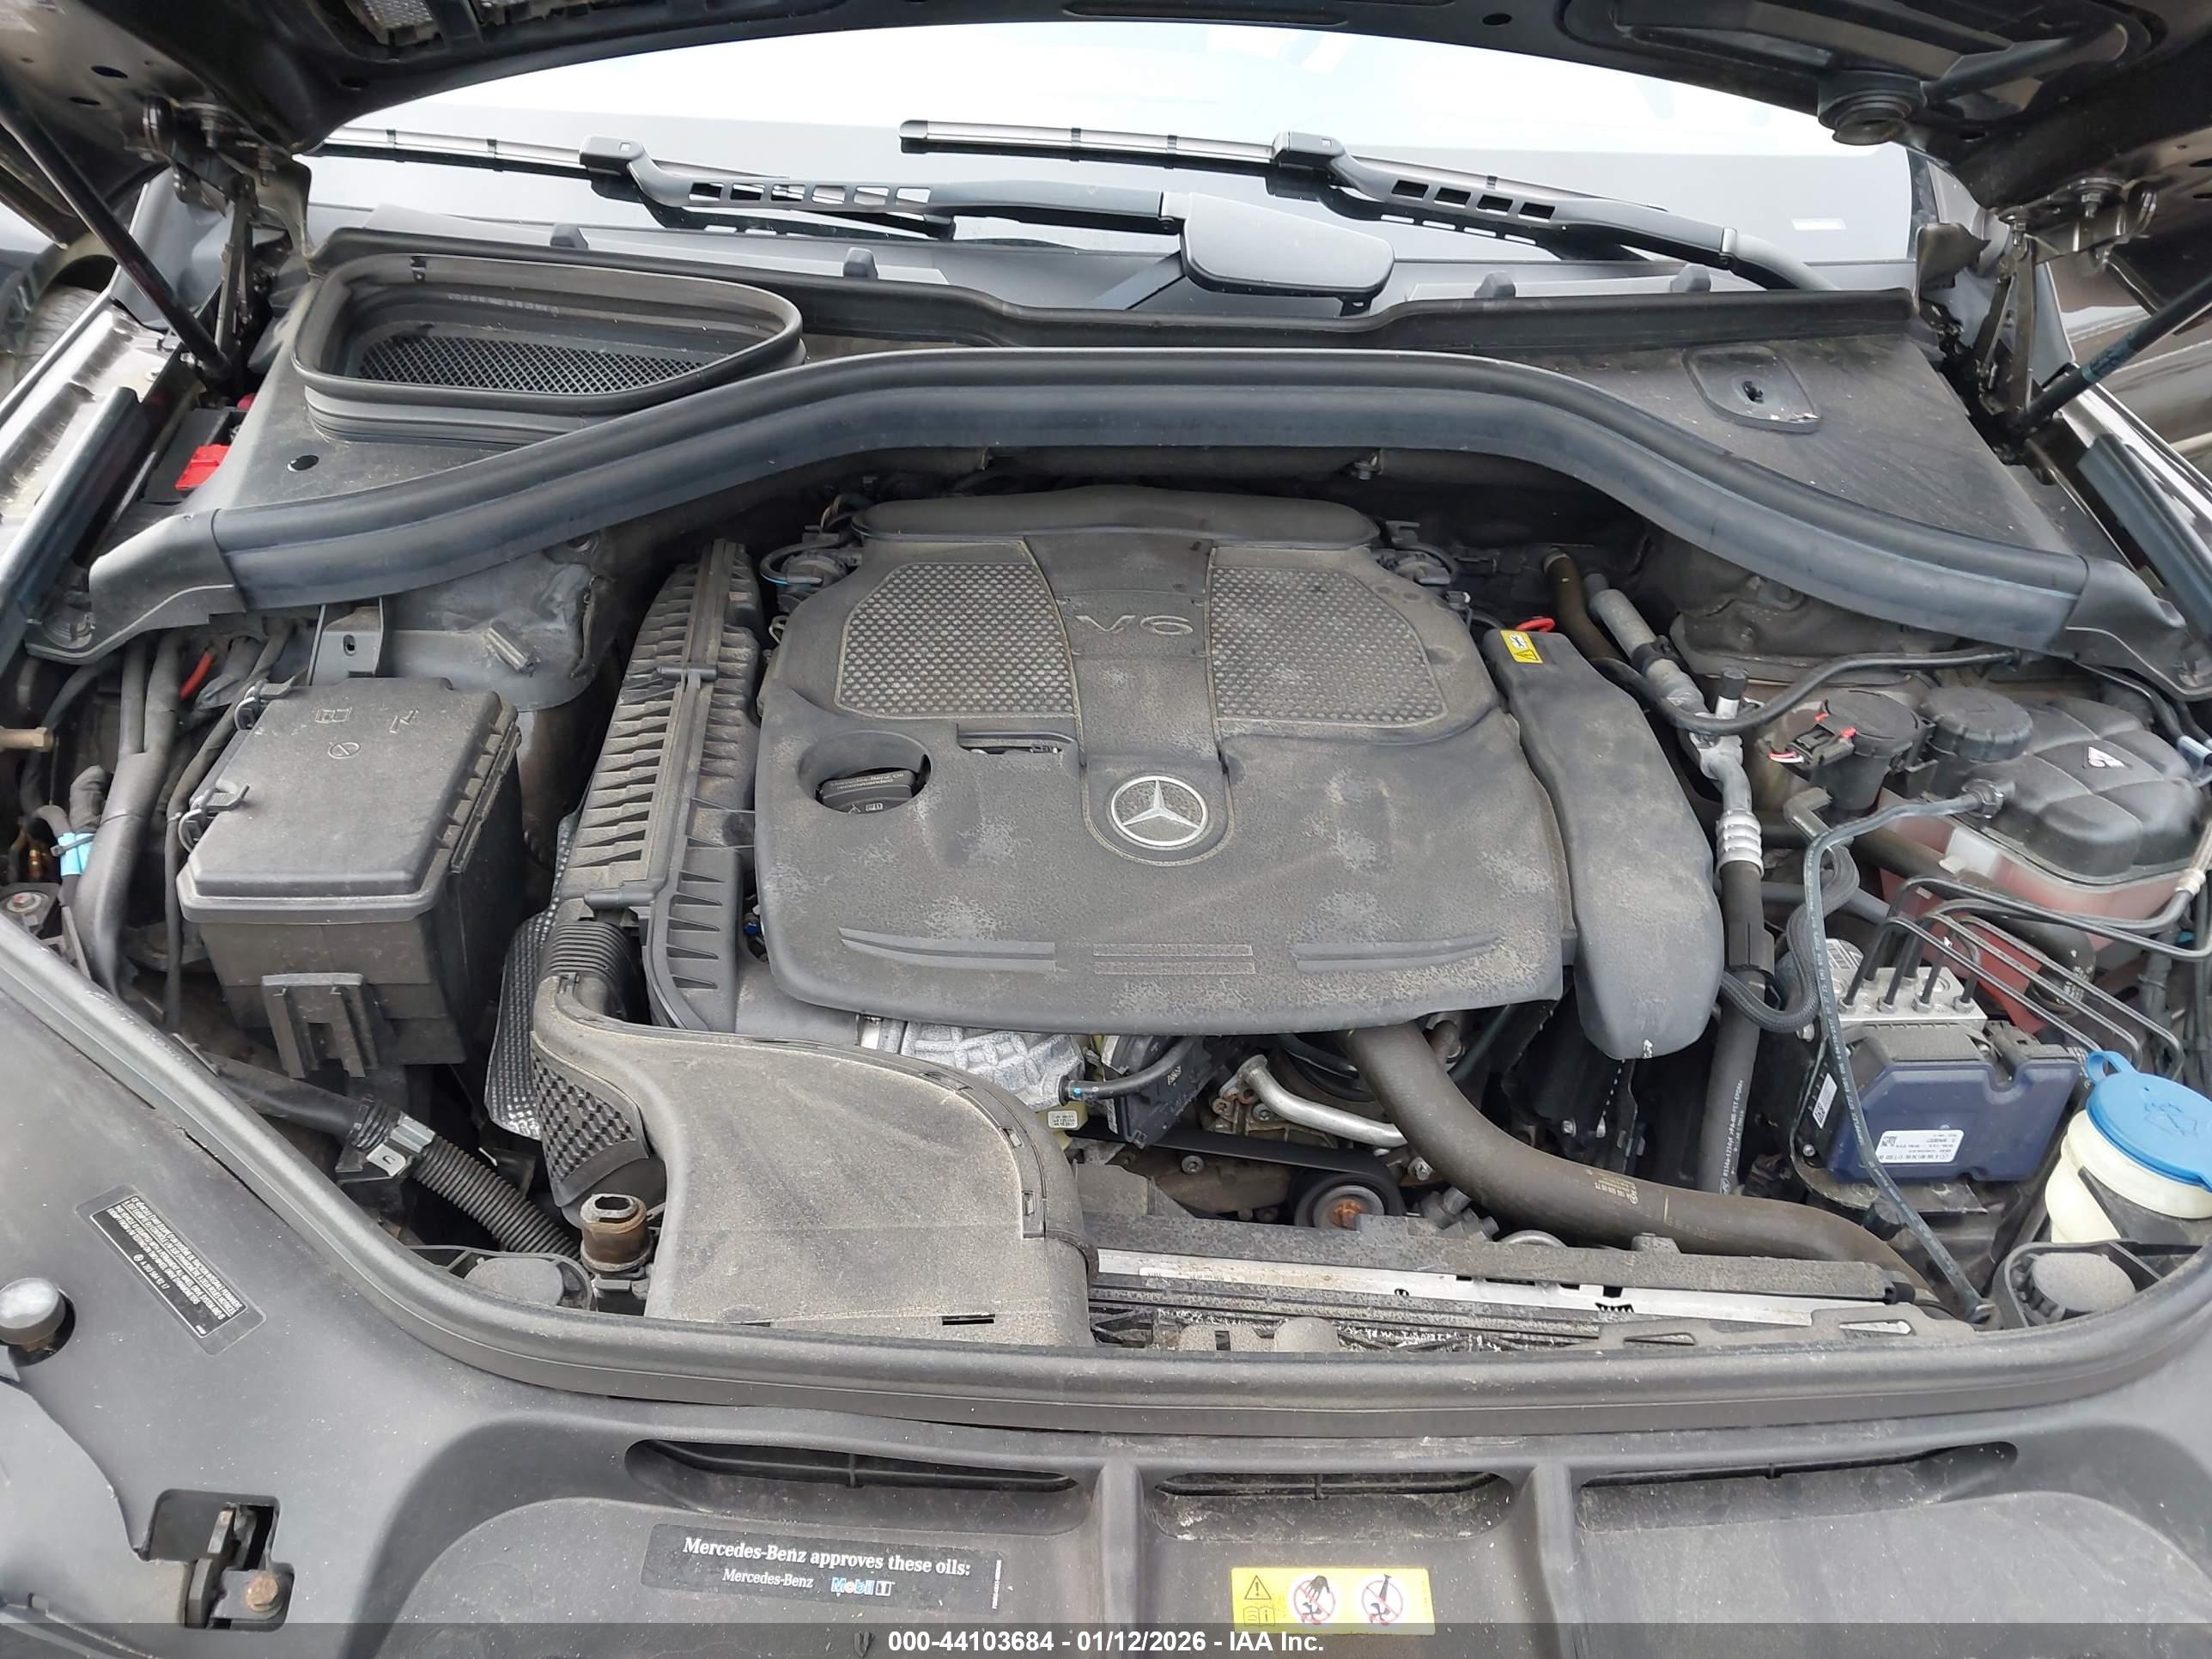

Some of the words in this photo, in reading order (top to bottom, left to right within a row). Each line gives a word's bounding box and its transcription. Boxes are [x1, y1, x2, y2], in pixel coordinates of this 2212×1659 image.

[1075, 614, 1194, 635] V6
[683, 1537, 807, 1564] Mercedes-Benz
[810, 1553, 884, 1569] approves
[888, 1555, 931, 1573] these
[935, 1559, 971, 1576] oils:
[722, 1568, 814, 1589] Mercedes-Benz
[831, 1577, 874, 1595] Mobil
